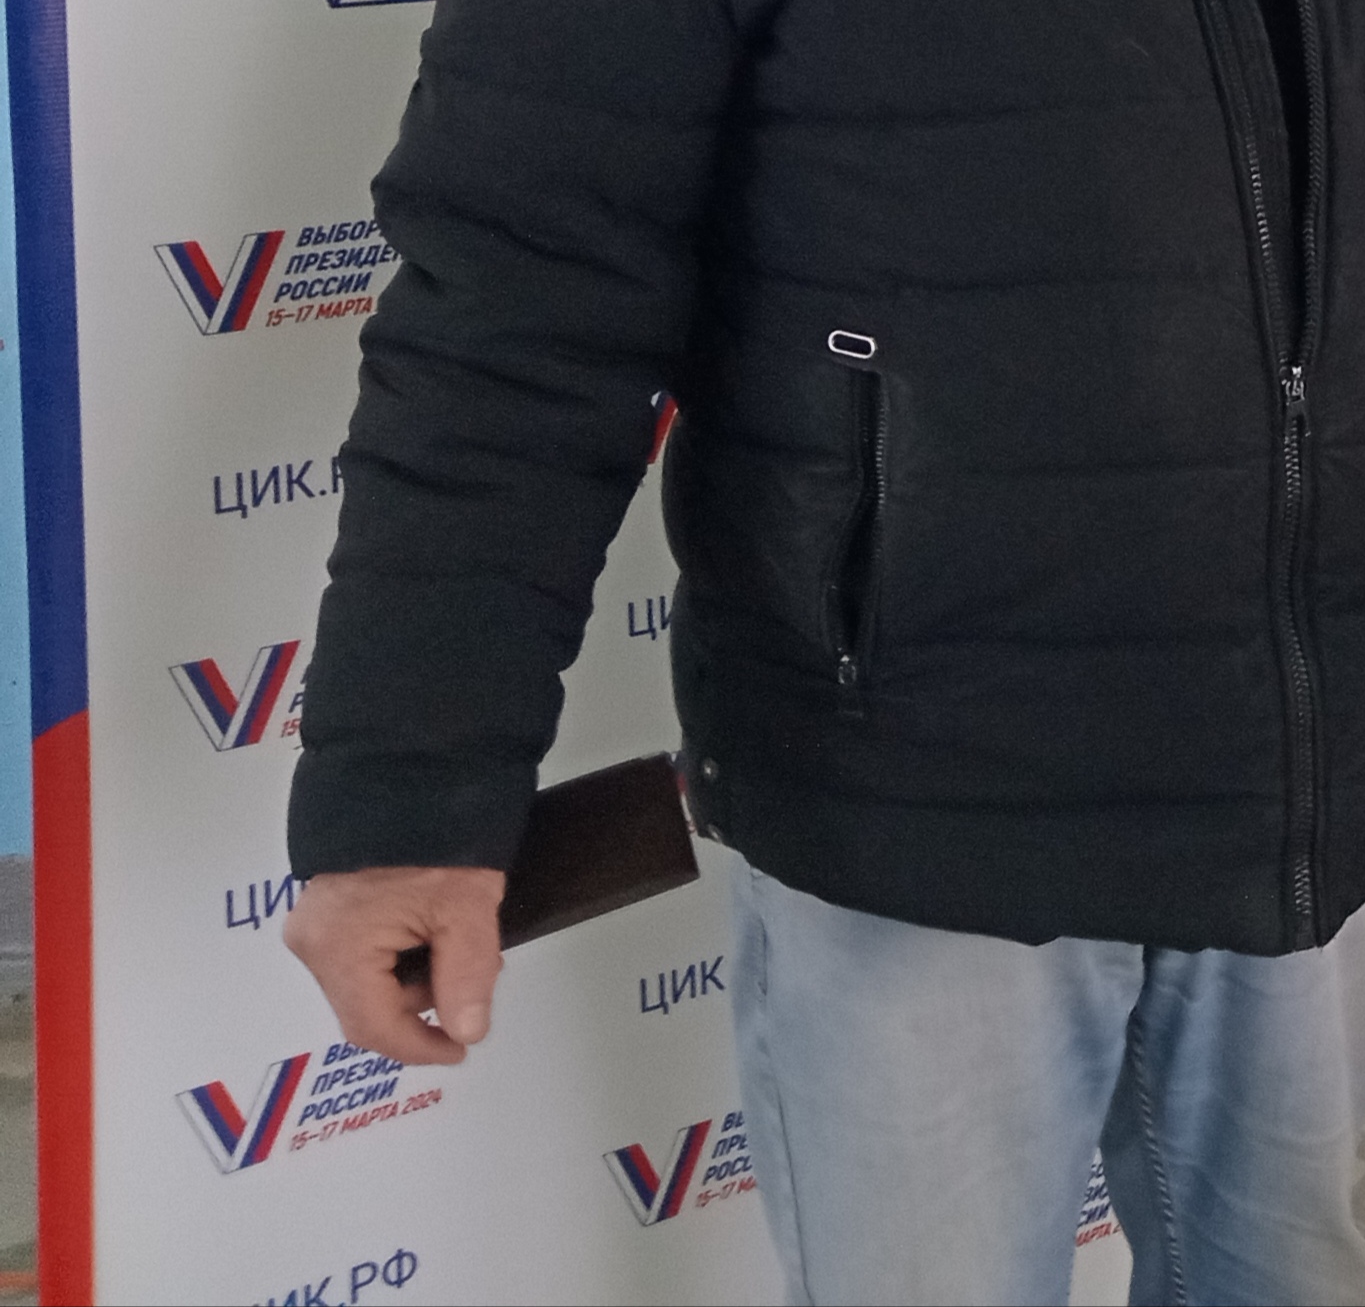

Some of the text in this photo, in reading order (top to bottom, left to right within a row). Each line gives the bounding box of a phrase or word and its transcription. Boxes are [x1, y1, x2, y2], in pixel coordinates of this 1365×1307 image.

[296, 220, 383, 248] ВЫБОР
[285, 243, 402, 275] ПРЕЗИДЕ
[273, 271, 372, 304] РОССИИ
[314, 296, 375, 321] МАРТА
[640, 955, 726, 1015] ЦИК
[310, 1056, 404, 1096] ПРЕЗИД
[297, 1077, 399, 1127] РОССИИ
[339, 1101, 399, 1134] МАРТА
[401, 1088, 443, 1115] 2024
[702, 1155, 753, 1186] РОСС
